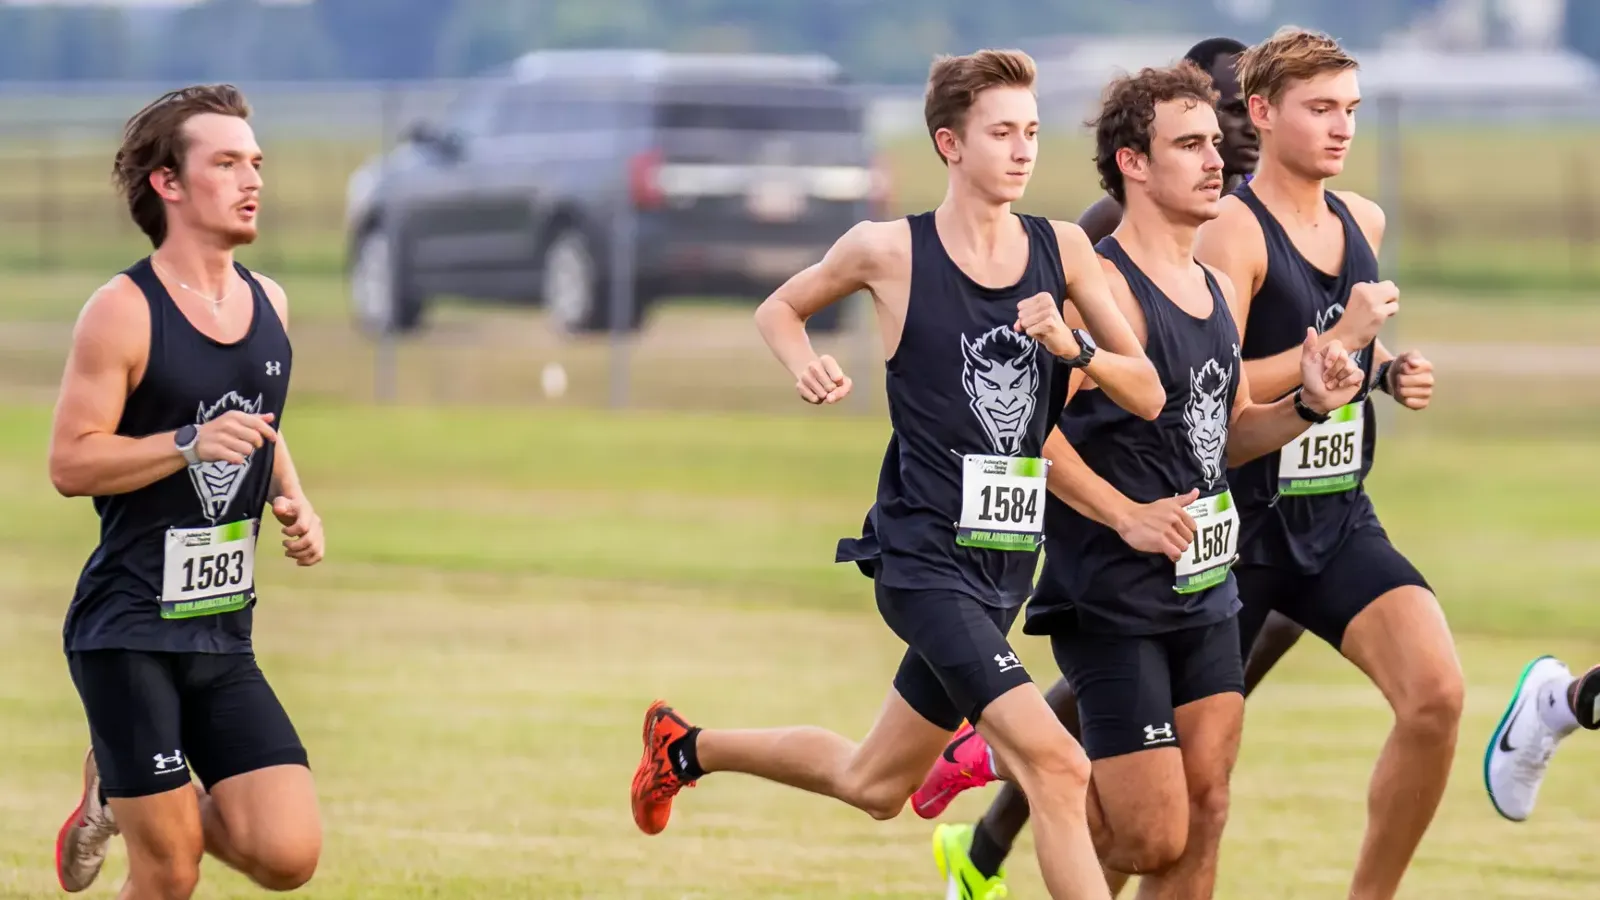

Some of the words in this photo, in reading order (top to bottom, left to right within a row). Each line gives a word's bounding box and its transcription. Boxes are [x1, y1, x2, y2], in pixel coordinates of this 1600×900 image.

[1298, 431, 1355, 469] 1585
[978, 485, 1038, 524] 1584
[1192, 518, 1232, 565] 1587
[181, 549, 244, 592] 1583
